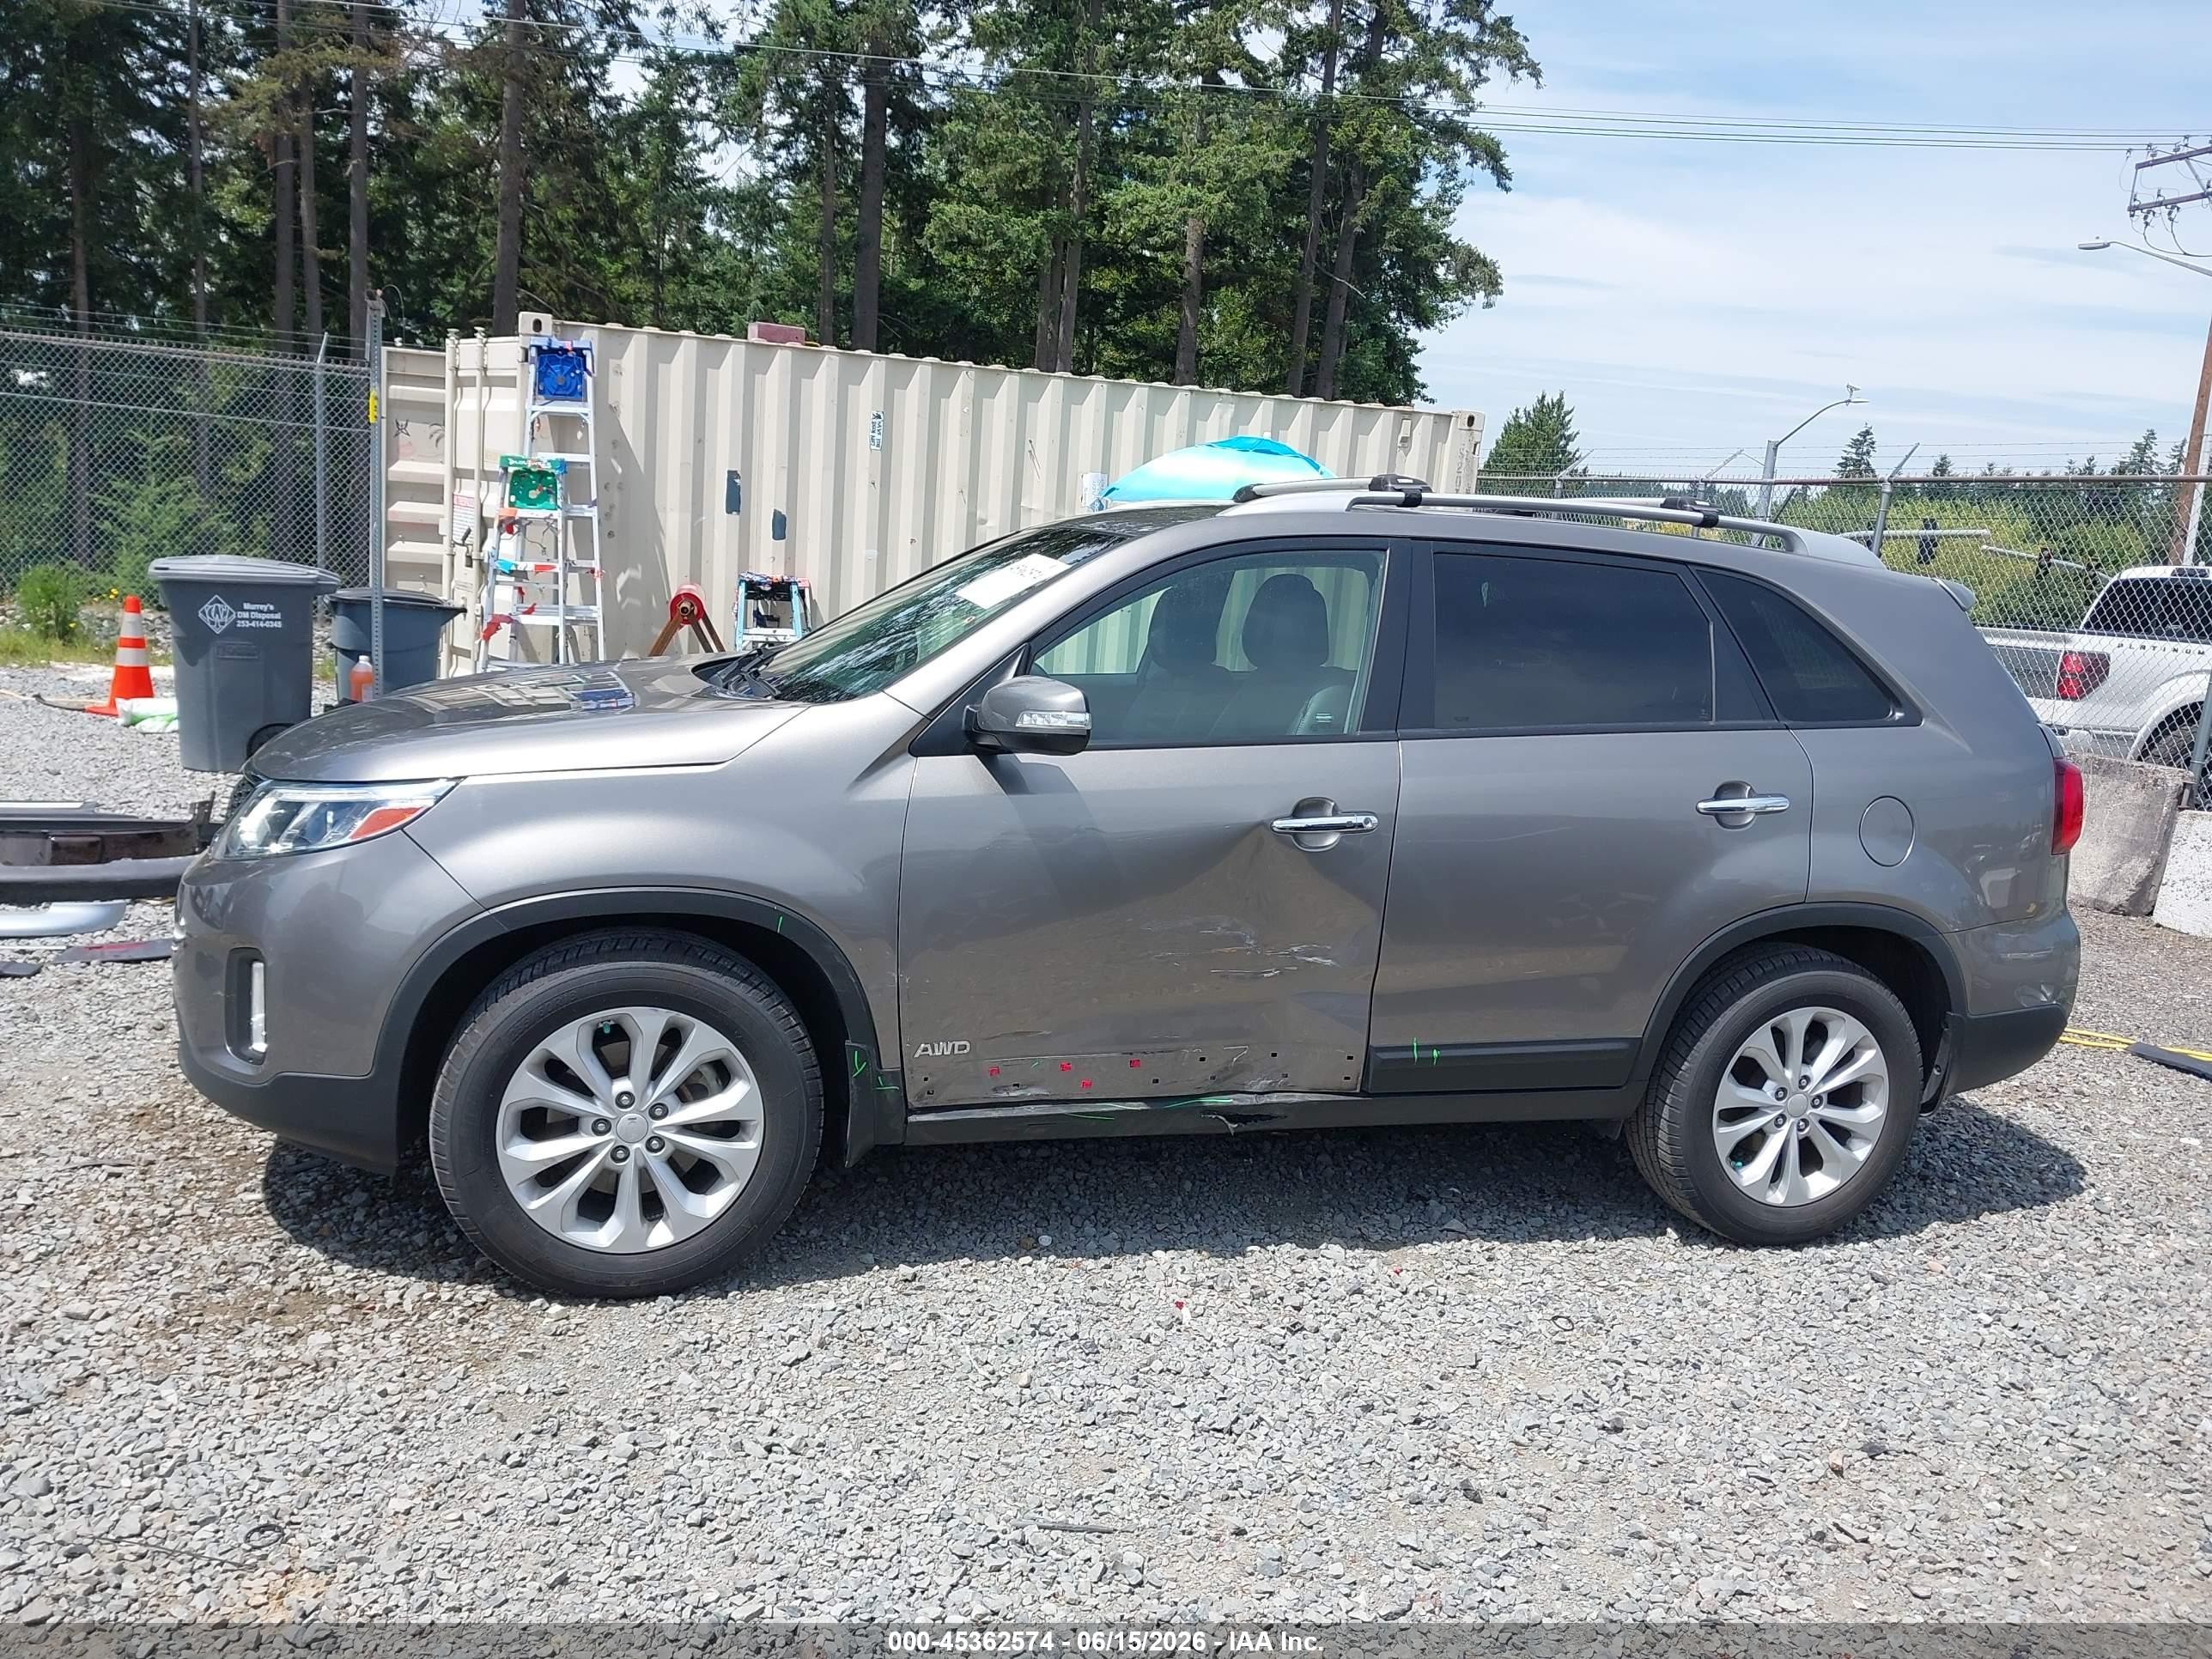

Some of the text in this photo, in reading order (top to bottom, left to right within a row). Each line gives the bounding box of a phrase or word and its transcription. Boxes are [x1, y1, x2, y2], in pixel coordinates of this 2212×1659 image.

[250, 611, 281, 620] Disposal
[2117, 642, 2205, 655] PLATINUM
[914, 1041, 970, 1058] AWD
